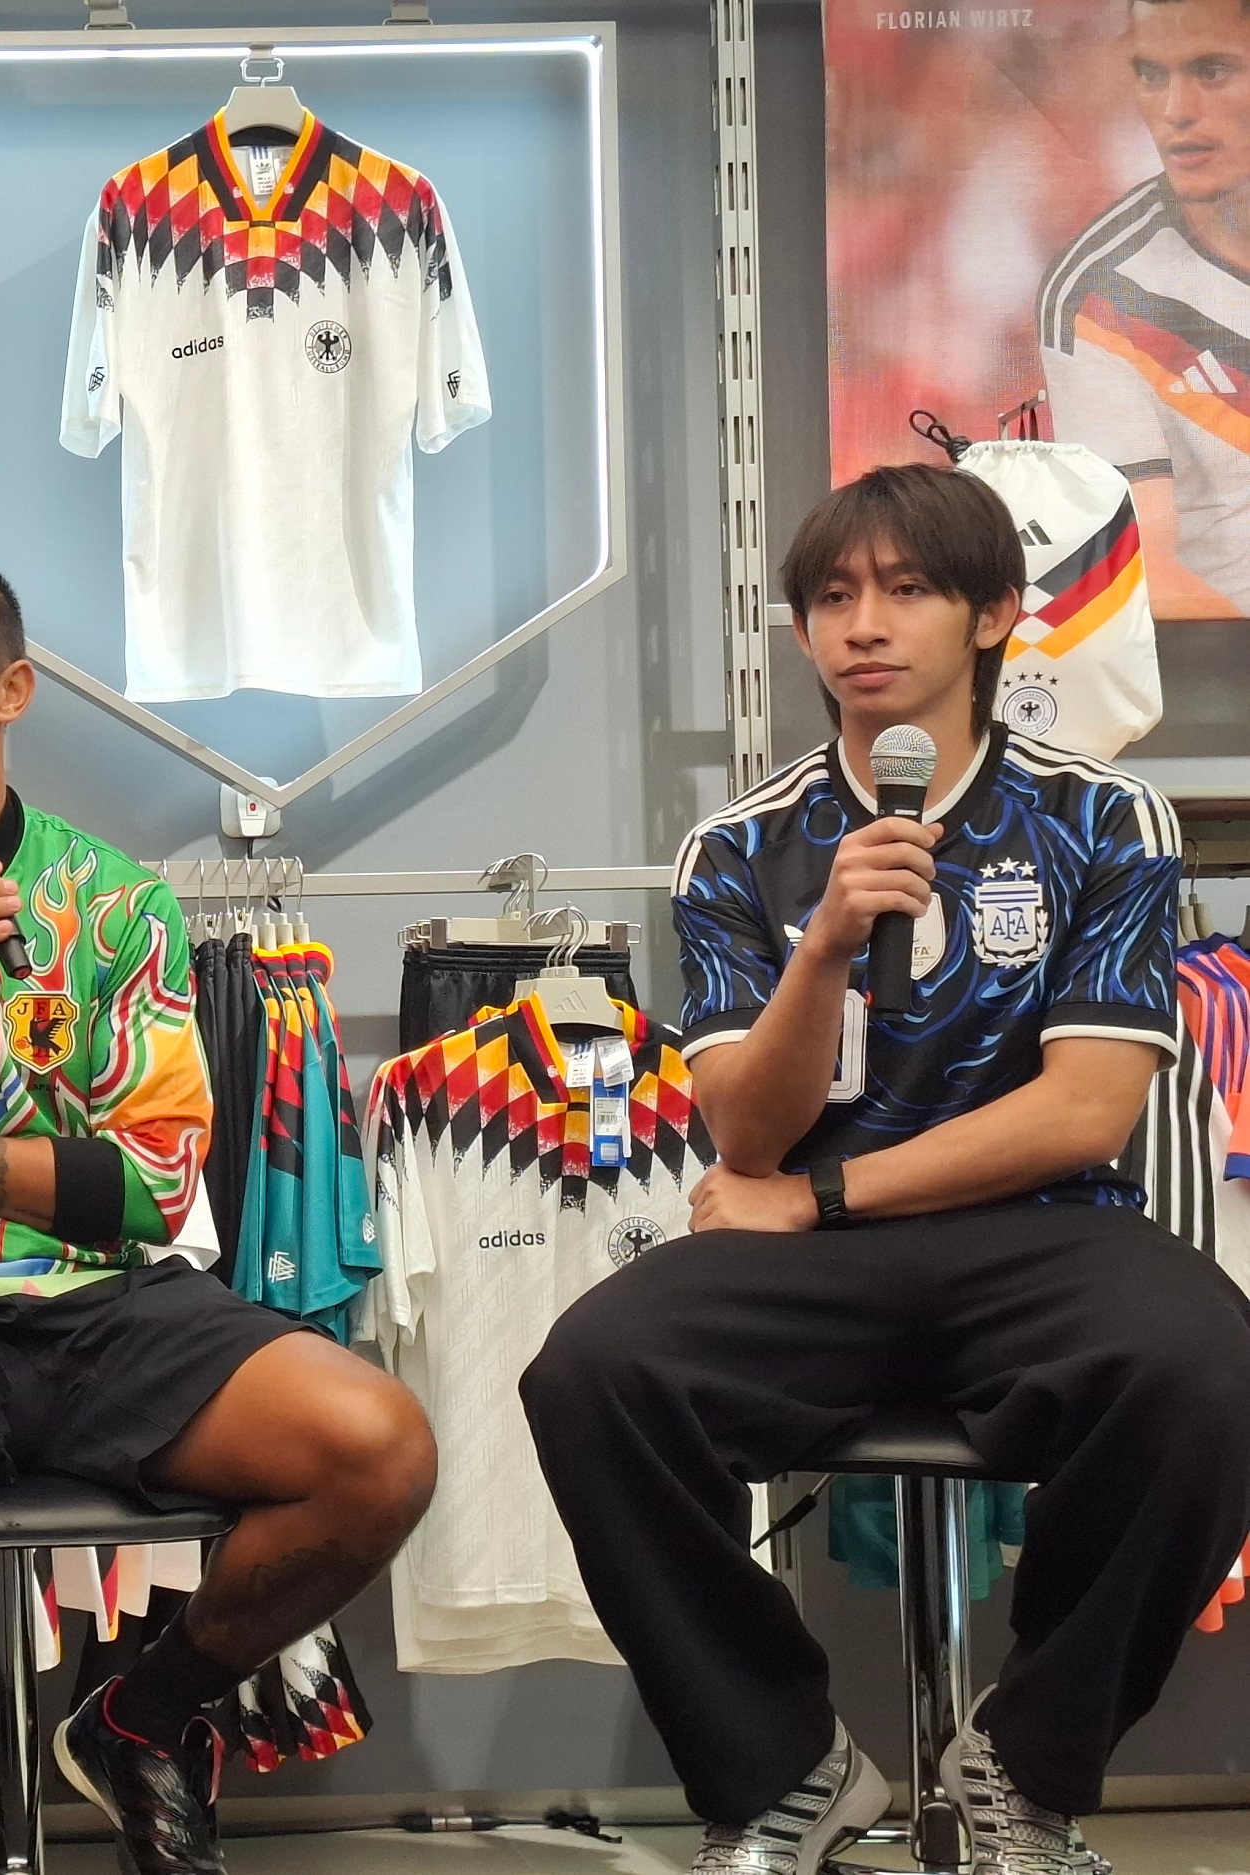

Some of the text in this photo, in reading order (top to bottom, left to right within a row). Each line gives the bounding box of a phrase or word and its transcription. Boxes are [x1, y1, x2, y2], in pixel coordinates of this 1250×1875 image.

[876, 9, 1034, 30] FLORIAN WIRTZ
[171, 334, 225, 359] adidas
[990, 907, 1031, 942] AFA
[479, 1230, 545, 1250] adidas
